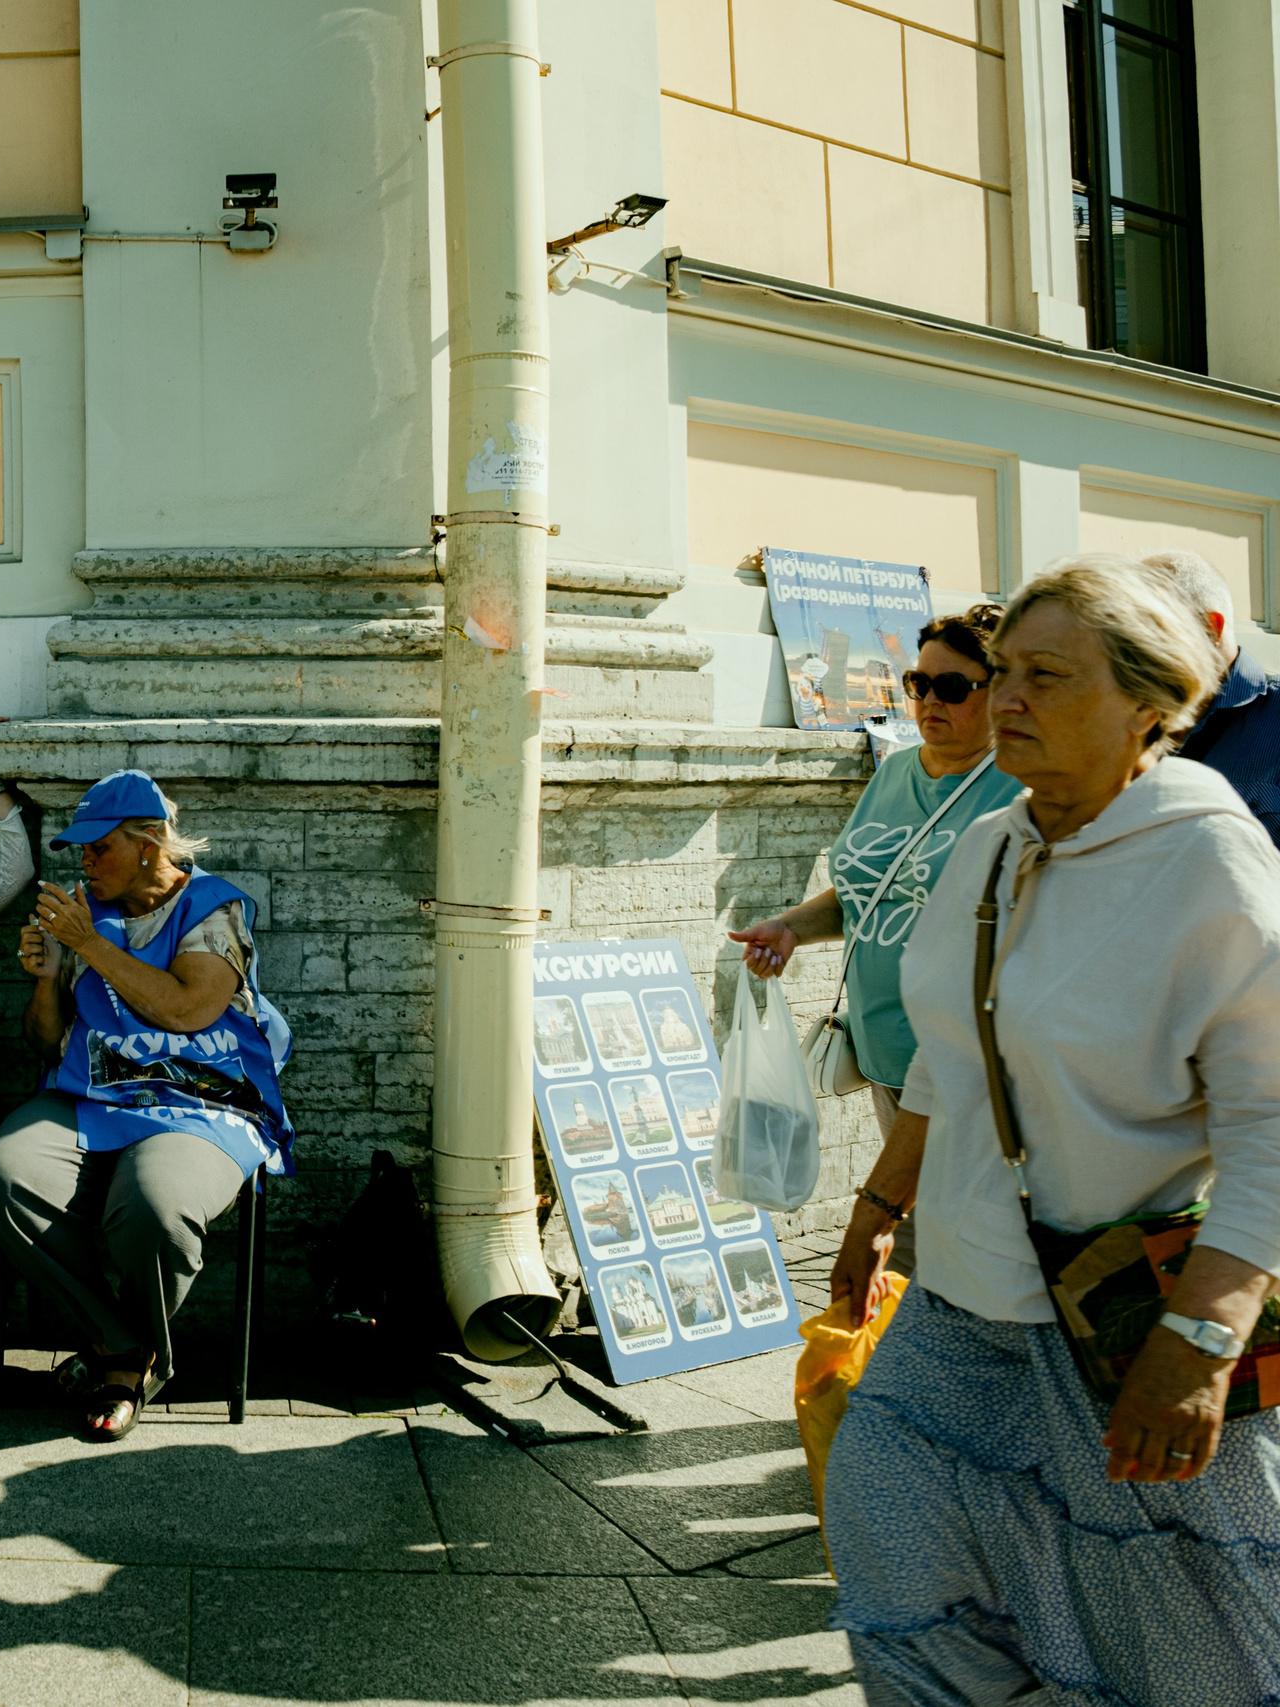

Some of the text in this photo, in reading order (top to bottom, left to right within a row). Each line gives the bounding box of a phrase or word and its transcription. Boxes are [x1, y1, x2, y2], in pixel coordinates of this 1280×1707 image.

[770, 558, 842, 583] НОЧНОЙ
[773, 577, 929, 616] (разводные мосты)
[533, 950, 679, 983] КСКУРСИИ
[612, 1059, 643, 1069] ПЕТЕРГОФ
[666, 1053, 702, 1063] КРОНШТАДТ
[553, 1066, 581, 1075] ПУШКИН
[637, 1145, 670, 1156] ПАВЛОВСК
[579, 1154, 605, 1164] ВЫБОРГ
[723, 1223, 752, 1235] МАРЬИНО
[607, 1245, 631, 1256] ПСКОВ
[751, 1312, 777, 1324] ВАЛААМ
[690, 1324, 723, 1337] РУСКЕАЛА
[625, 1336, 667, 1351] В.НОВГОРОД
